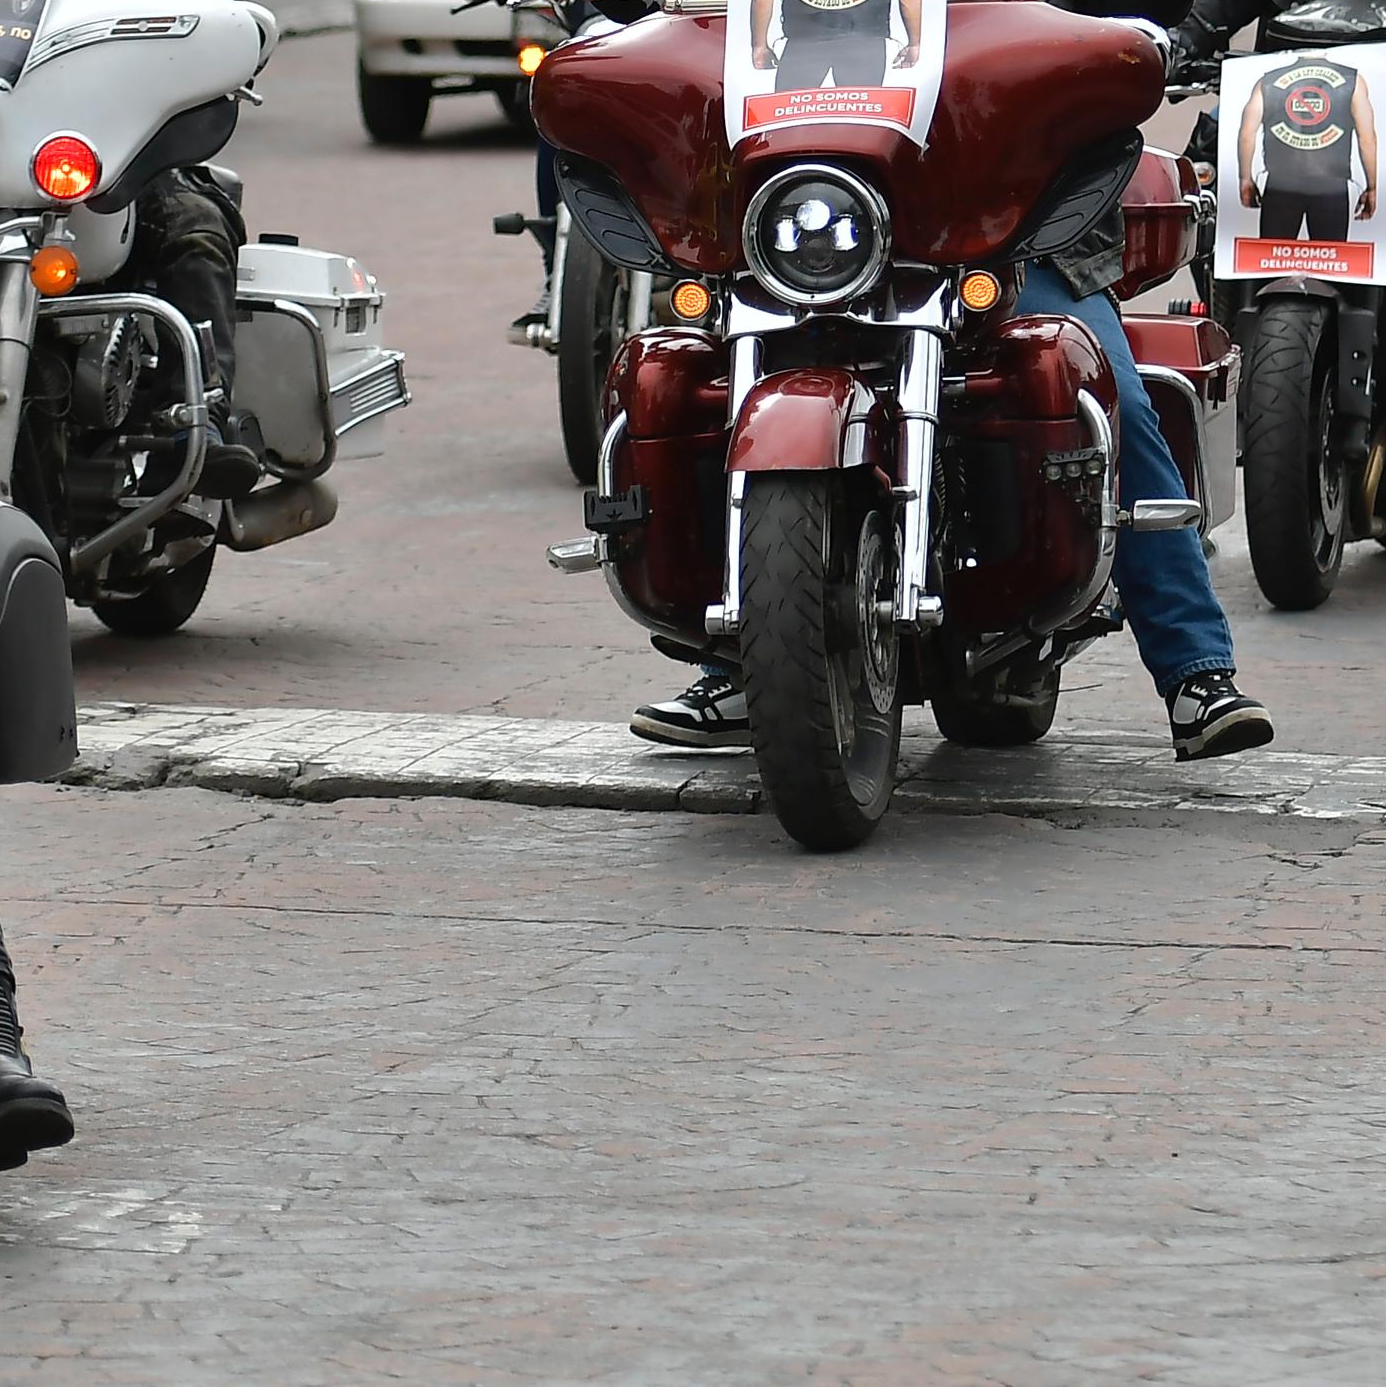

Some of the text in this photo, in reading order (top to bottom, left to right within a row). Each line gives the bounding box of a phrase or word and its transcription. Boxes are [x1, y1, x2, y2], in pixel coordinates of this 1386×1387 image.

[10, 27, 31, 40] no
[790, 92, 869, 104] NO SOMOS
[774, 103, 883, 117] DELINCUENTES
[1272, 245, 1337, 259] NO SOMOS
[1260, 258, 1348, 272] DELINCUENTES
